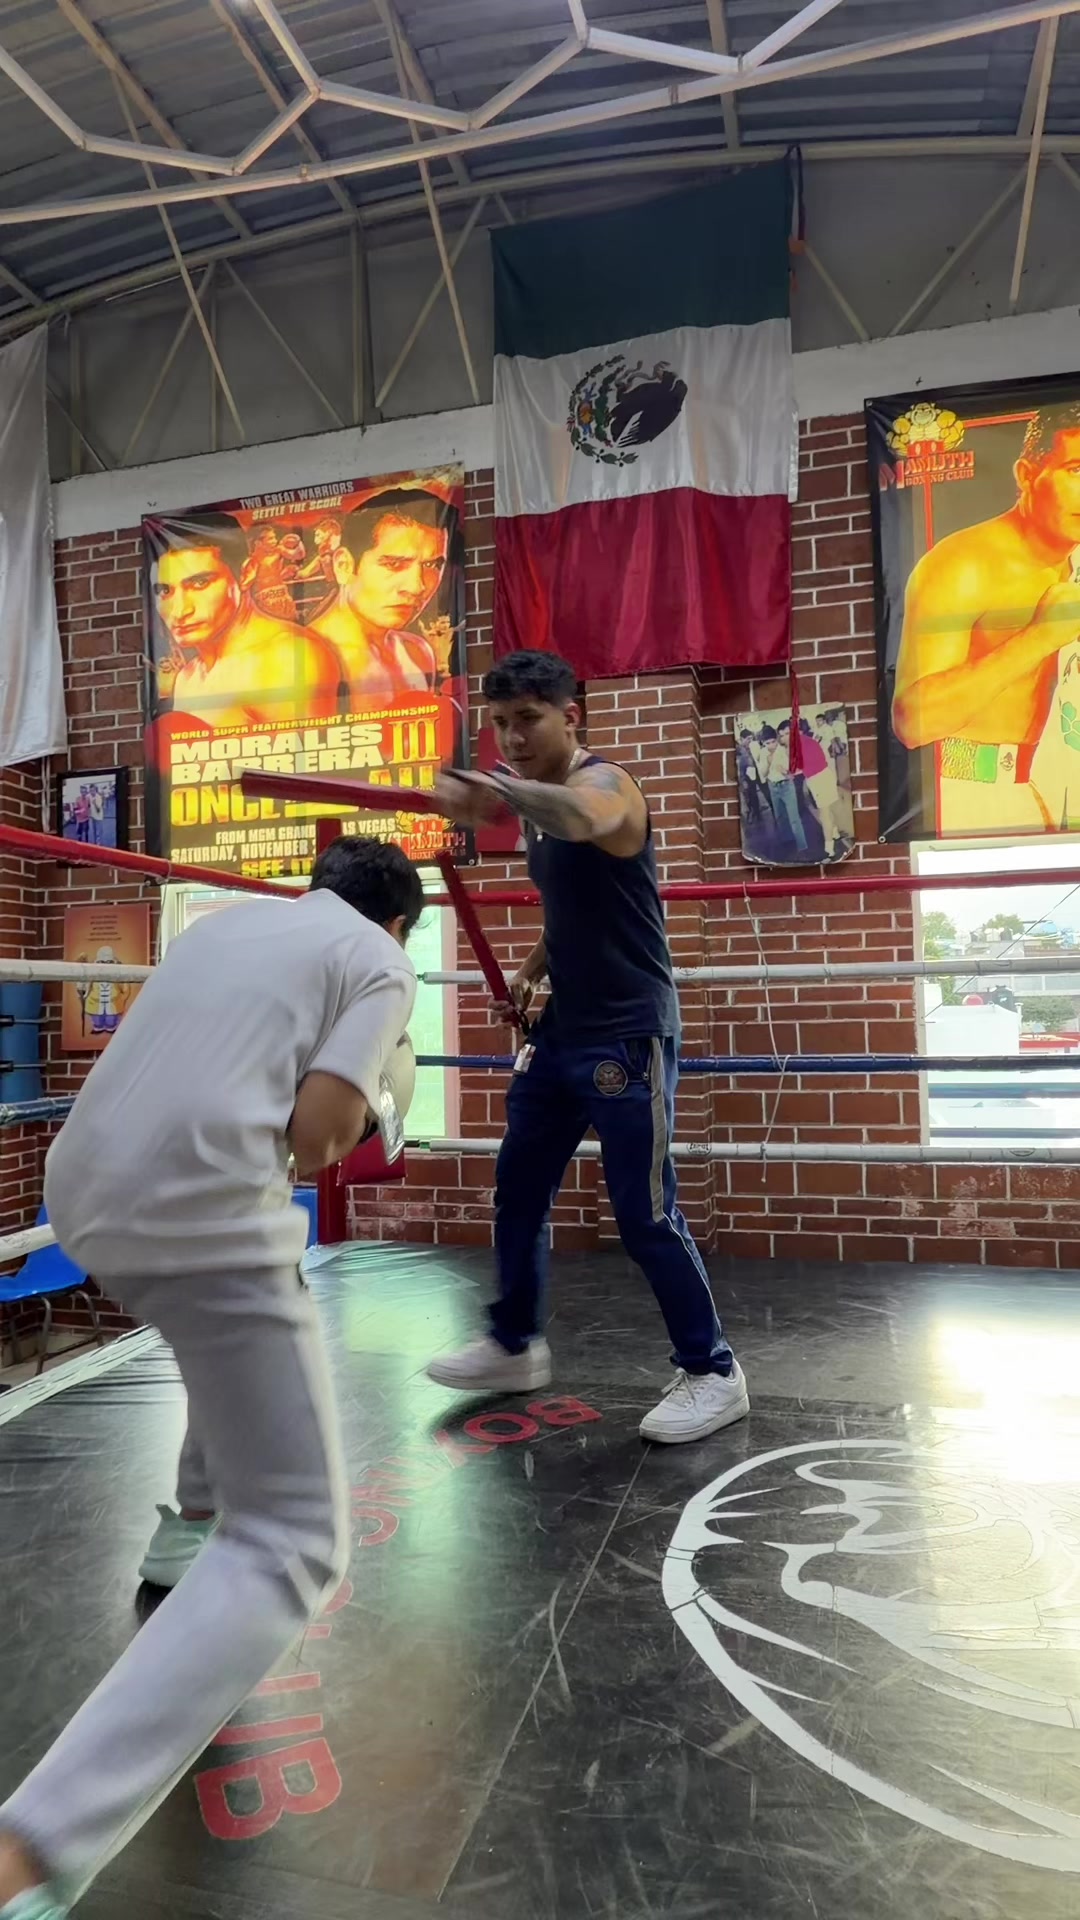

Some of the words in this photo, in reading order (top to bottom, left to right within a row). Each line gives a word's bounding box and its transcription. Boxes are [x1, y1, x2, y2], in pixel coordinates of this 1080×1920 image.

[946, 469, 975, 481] CLUB
[240, 496, 262, 510] TWO
[264, 490, 295, 506] GREAT
[297, 481, 354, 501] WARRIORS
[252, 504, 285, 520] SETTLE
[289, 501, 306, 514] THE
[309, 496, 342, 510] SCORE
[171, 729, 209, 741] WORLD
[213, 726, 249, 737] SUPER
[252, 714, 343, 732] FEATHERWEIGHT
[345, 704, 439, 723] CHAMPIONSHIP
[170, 723, 383, 764] MORALES
[171, 745, 384, 785] BARRERA
[216, 830, 246, 845] FROM
[248, 828, 276, 842] MGM
[278, 824, 316, 840] GRAND
[358, 817, 396, 834] VEGAS
[171, 845, 238, 864] SATURDAY,
[241, 839, 309, 860] NOVEMBER
[241, 859, 284, 878] SEE
[290, 857, 314, 876] IT
